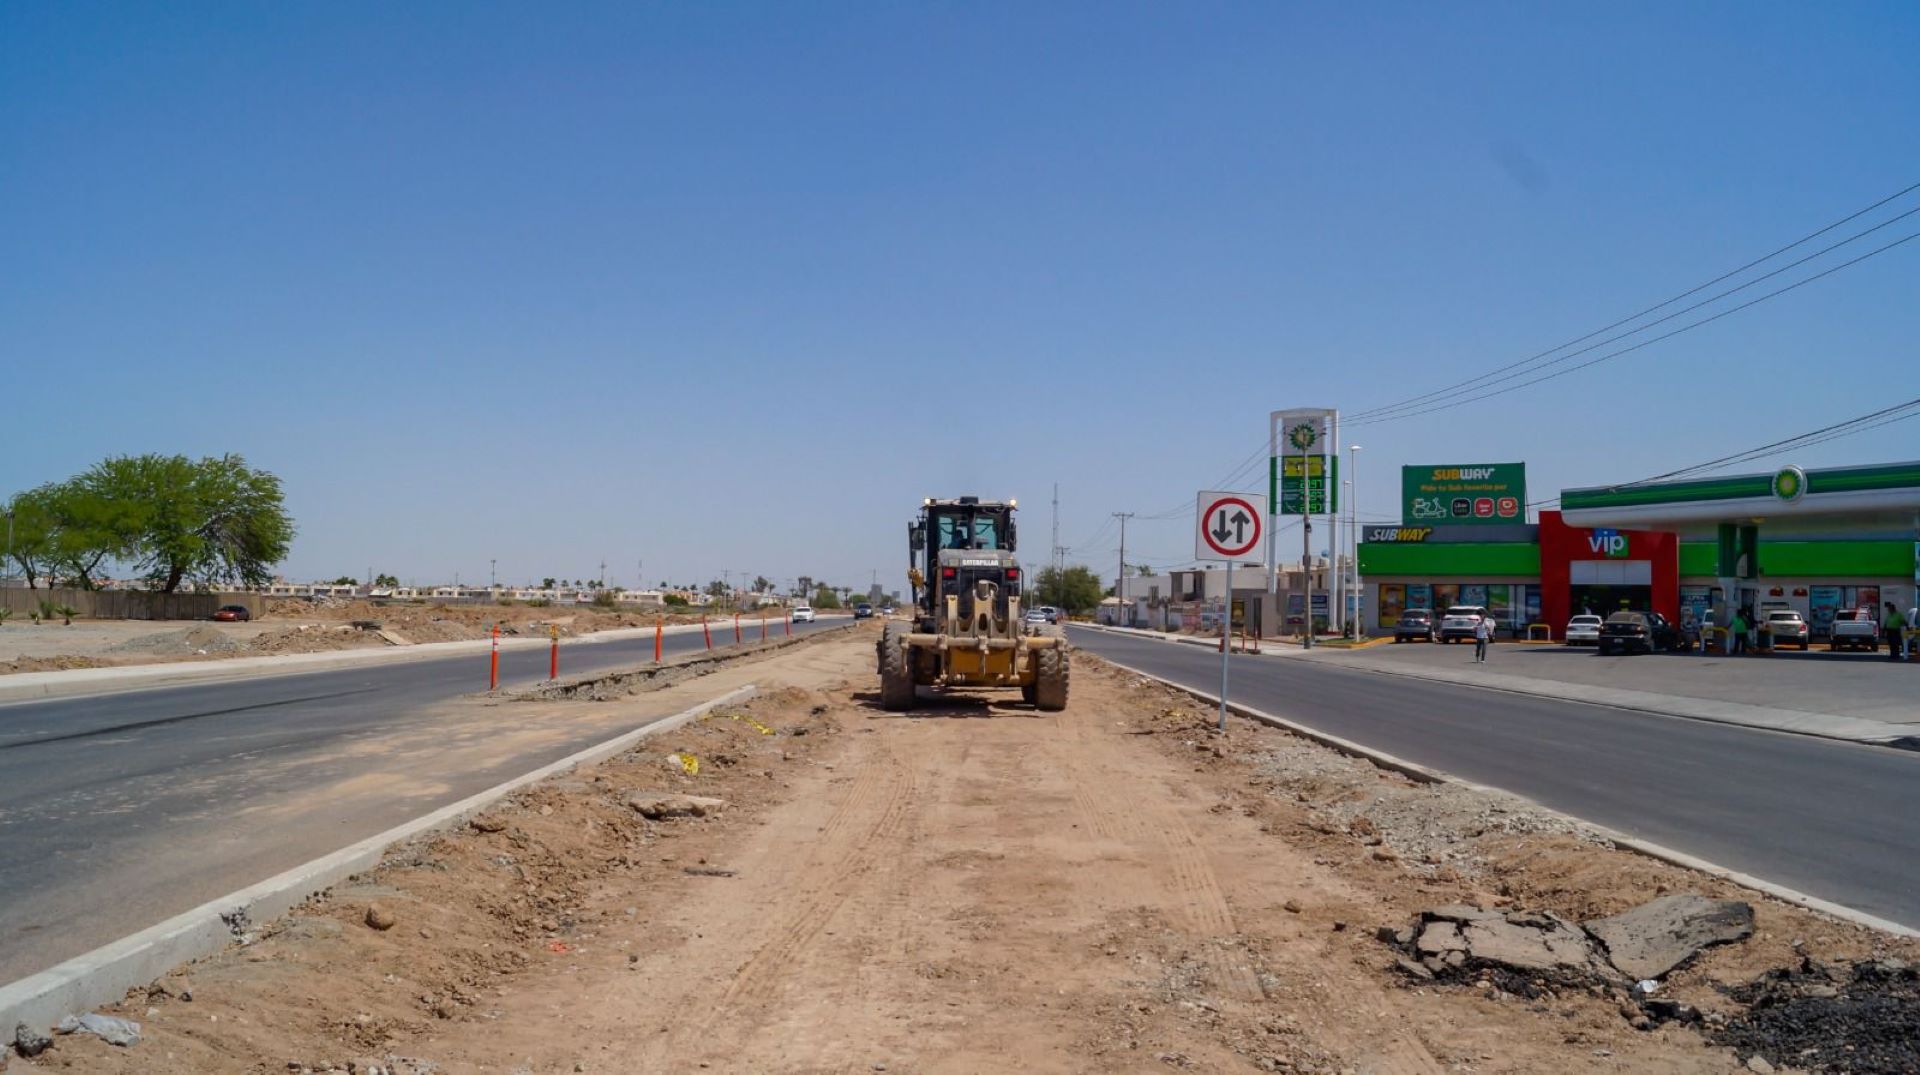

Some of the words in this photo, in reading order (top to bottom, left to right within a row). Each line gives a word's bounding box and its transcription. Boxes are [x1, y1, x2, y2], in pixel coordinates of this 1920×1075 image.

[1432, 468, 1495, 481] SUBWAY
[1368, 528, 1431, 541] SUBWAY
[1587, 530, 1625, 556] vip
